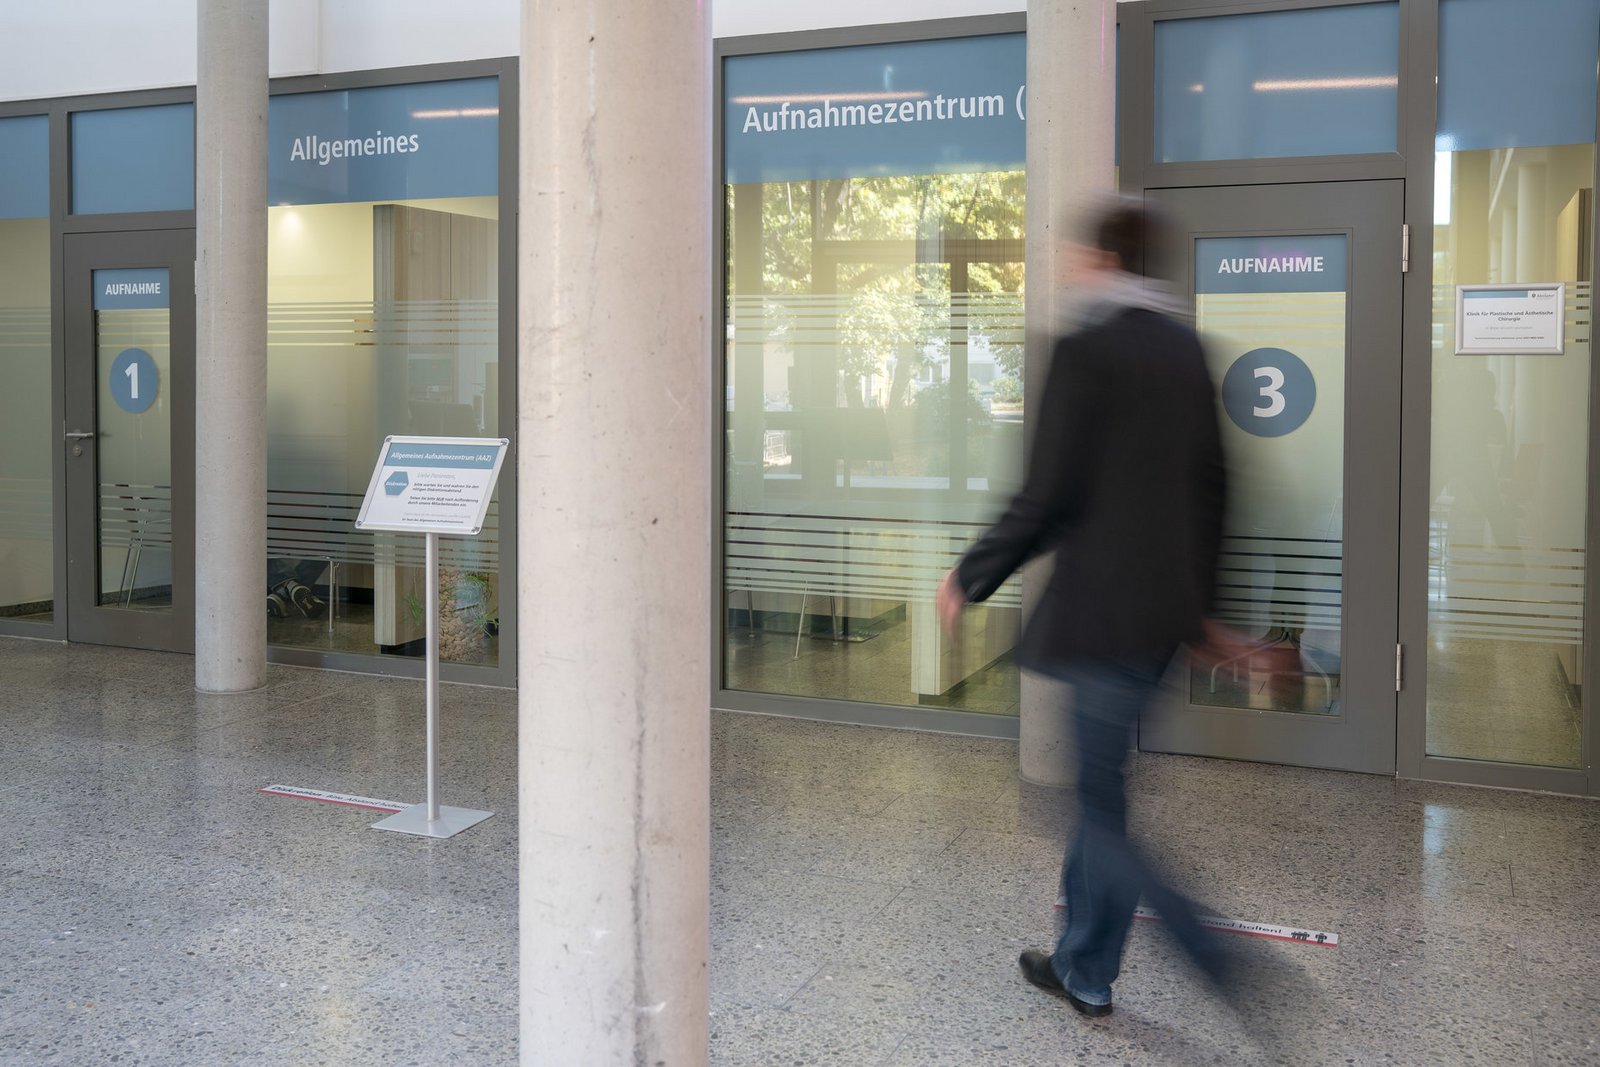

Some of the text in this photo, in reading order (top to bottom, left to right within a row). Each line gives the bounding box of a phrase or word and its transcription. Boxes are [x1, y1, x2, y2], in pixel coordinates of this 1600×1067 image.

[742, 94, 1004, 134] Aufnahmezentrum
[290, 130, 419, 166] Allgemeines
[1218, 256, 1324, 274] AUFNAHME
[105, 282, 161, 295] AUFNAHME
[125, 362, 139, 399] 1
[1253, 366, 1286, 418] 3
[391, 452, 424, 461] Allgemeines
[425, 453, 475, 462] Aufnahmezentrum
[1238, 923, 1282, 933] halten!
